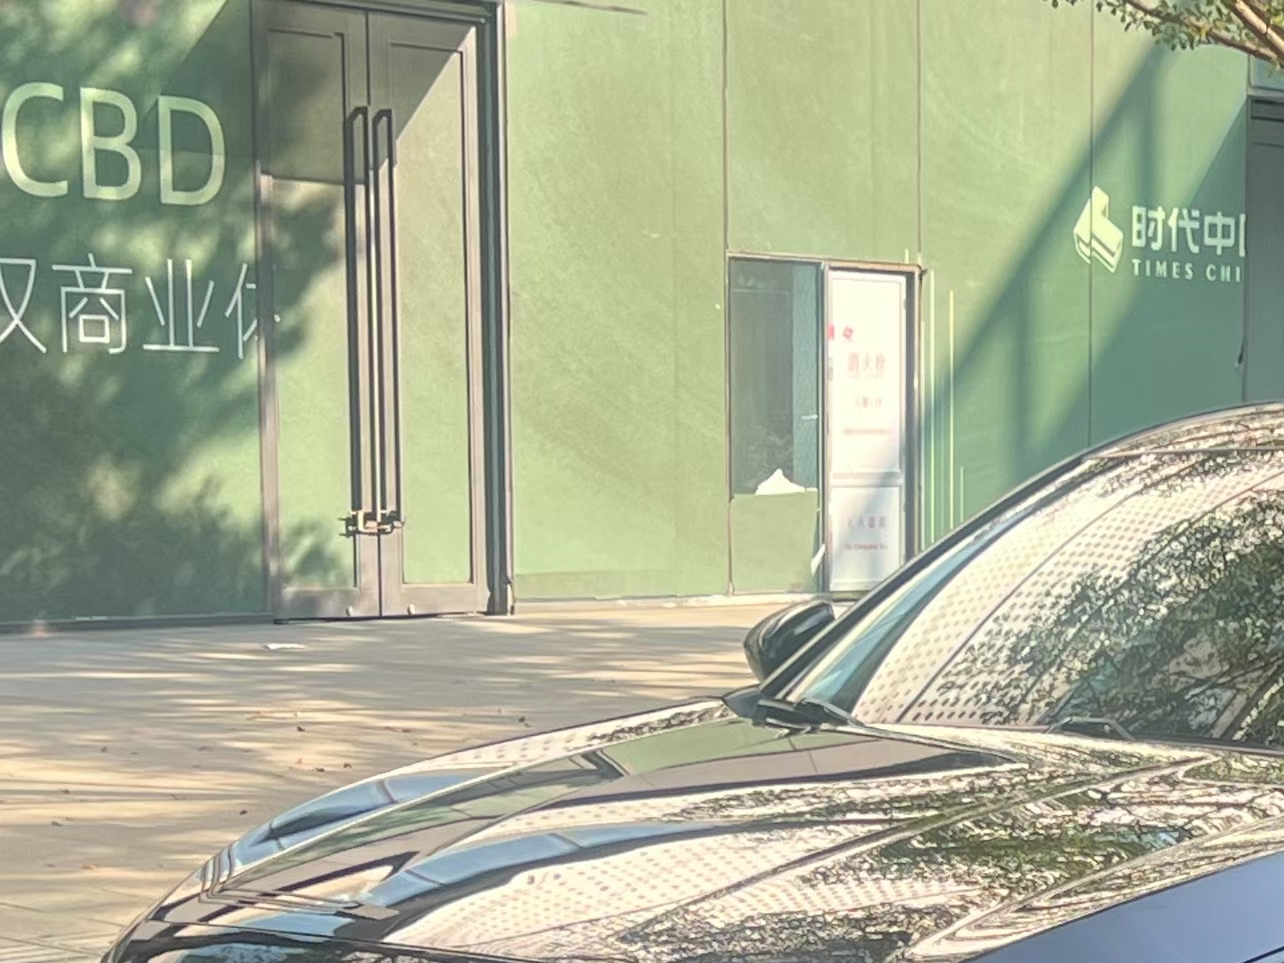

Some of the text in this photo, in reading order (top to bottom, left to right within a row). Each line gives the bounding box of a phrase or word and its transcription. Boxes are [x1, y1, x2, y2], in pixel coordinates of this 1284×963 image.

[1, 82, 227, 206] CBD
[1131, 204, 1247, 258] 时代中
[1131, 258, 1195, 280] TIMES
